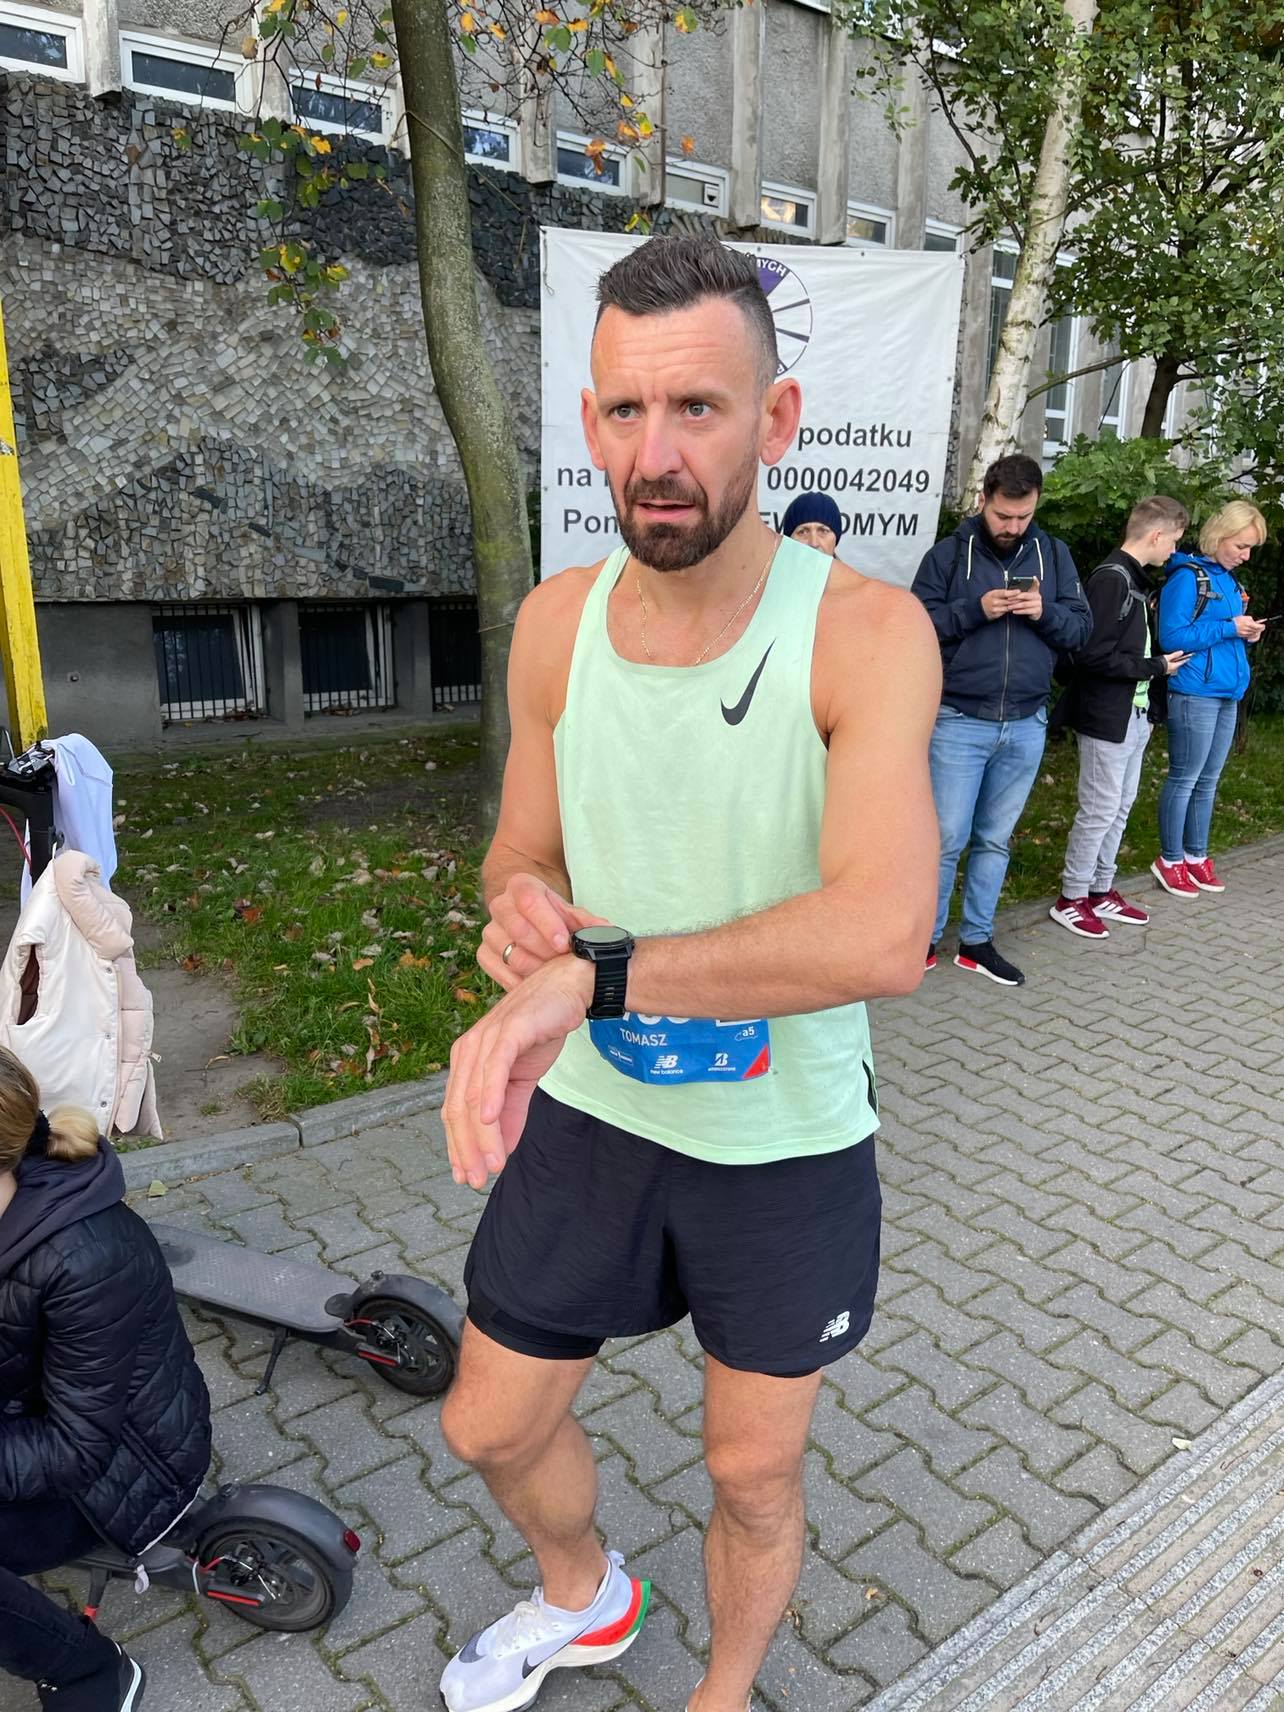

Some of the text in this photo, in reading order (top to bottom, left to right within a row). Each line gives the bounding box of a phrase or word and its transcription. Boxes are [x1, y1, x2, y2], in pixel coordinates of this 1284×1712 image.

[798, 422, 912, 451] podatku
[557, 467, 592, 487] na
[767, 466, 930, 493] 0000042049
[619, 1027, 668, 1047] TOMASZ
